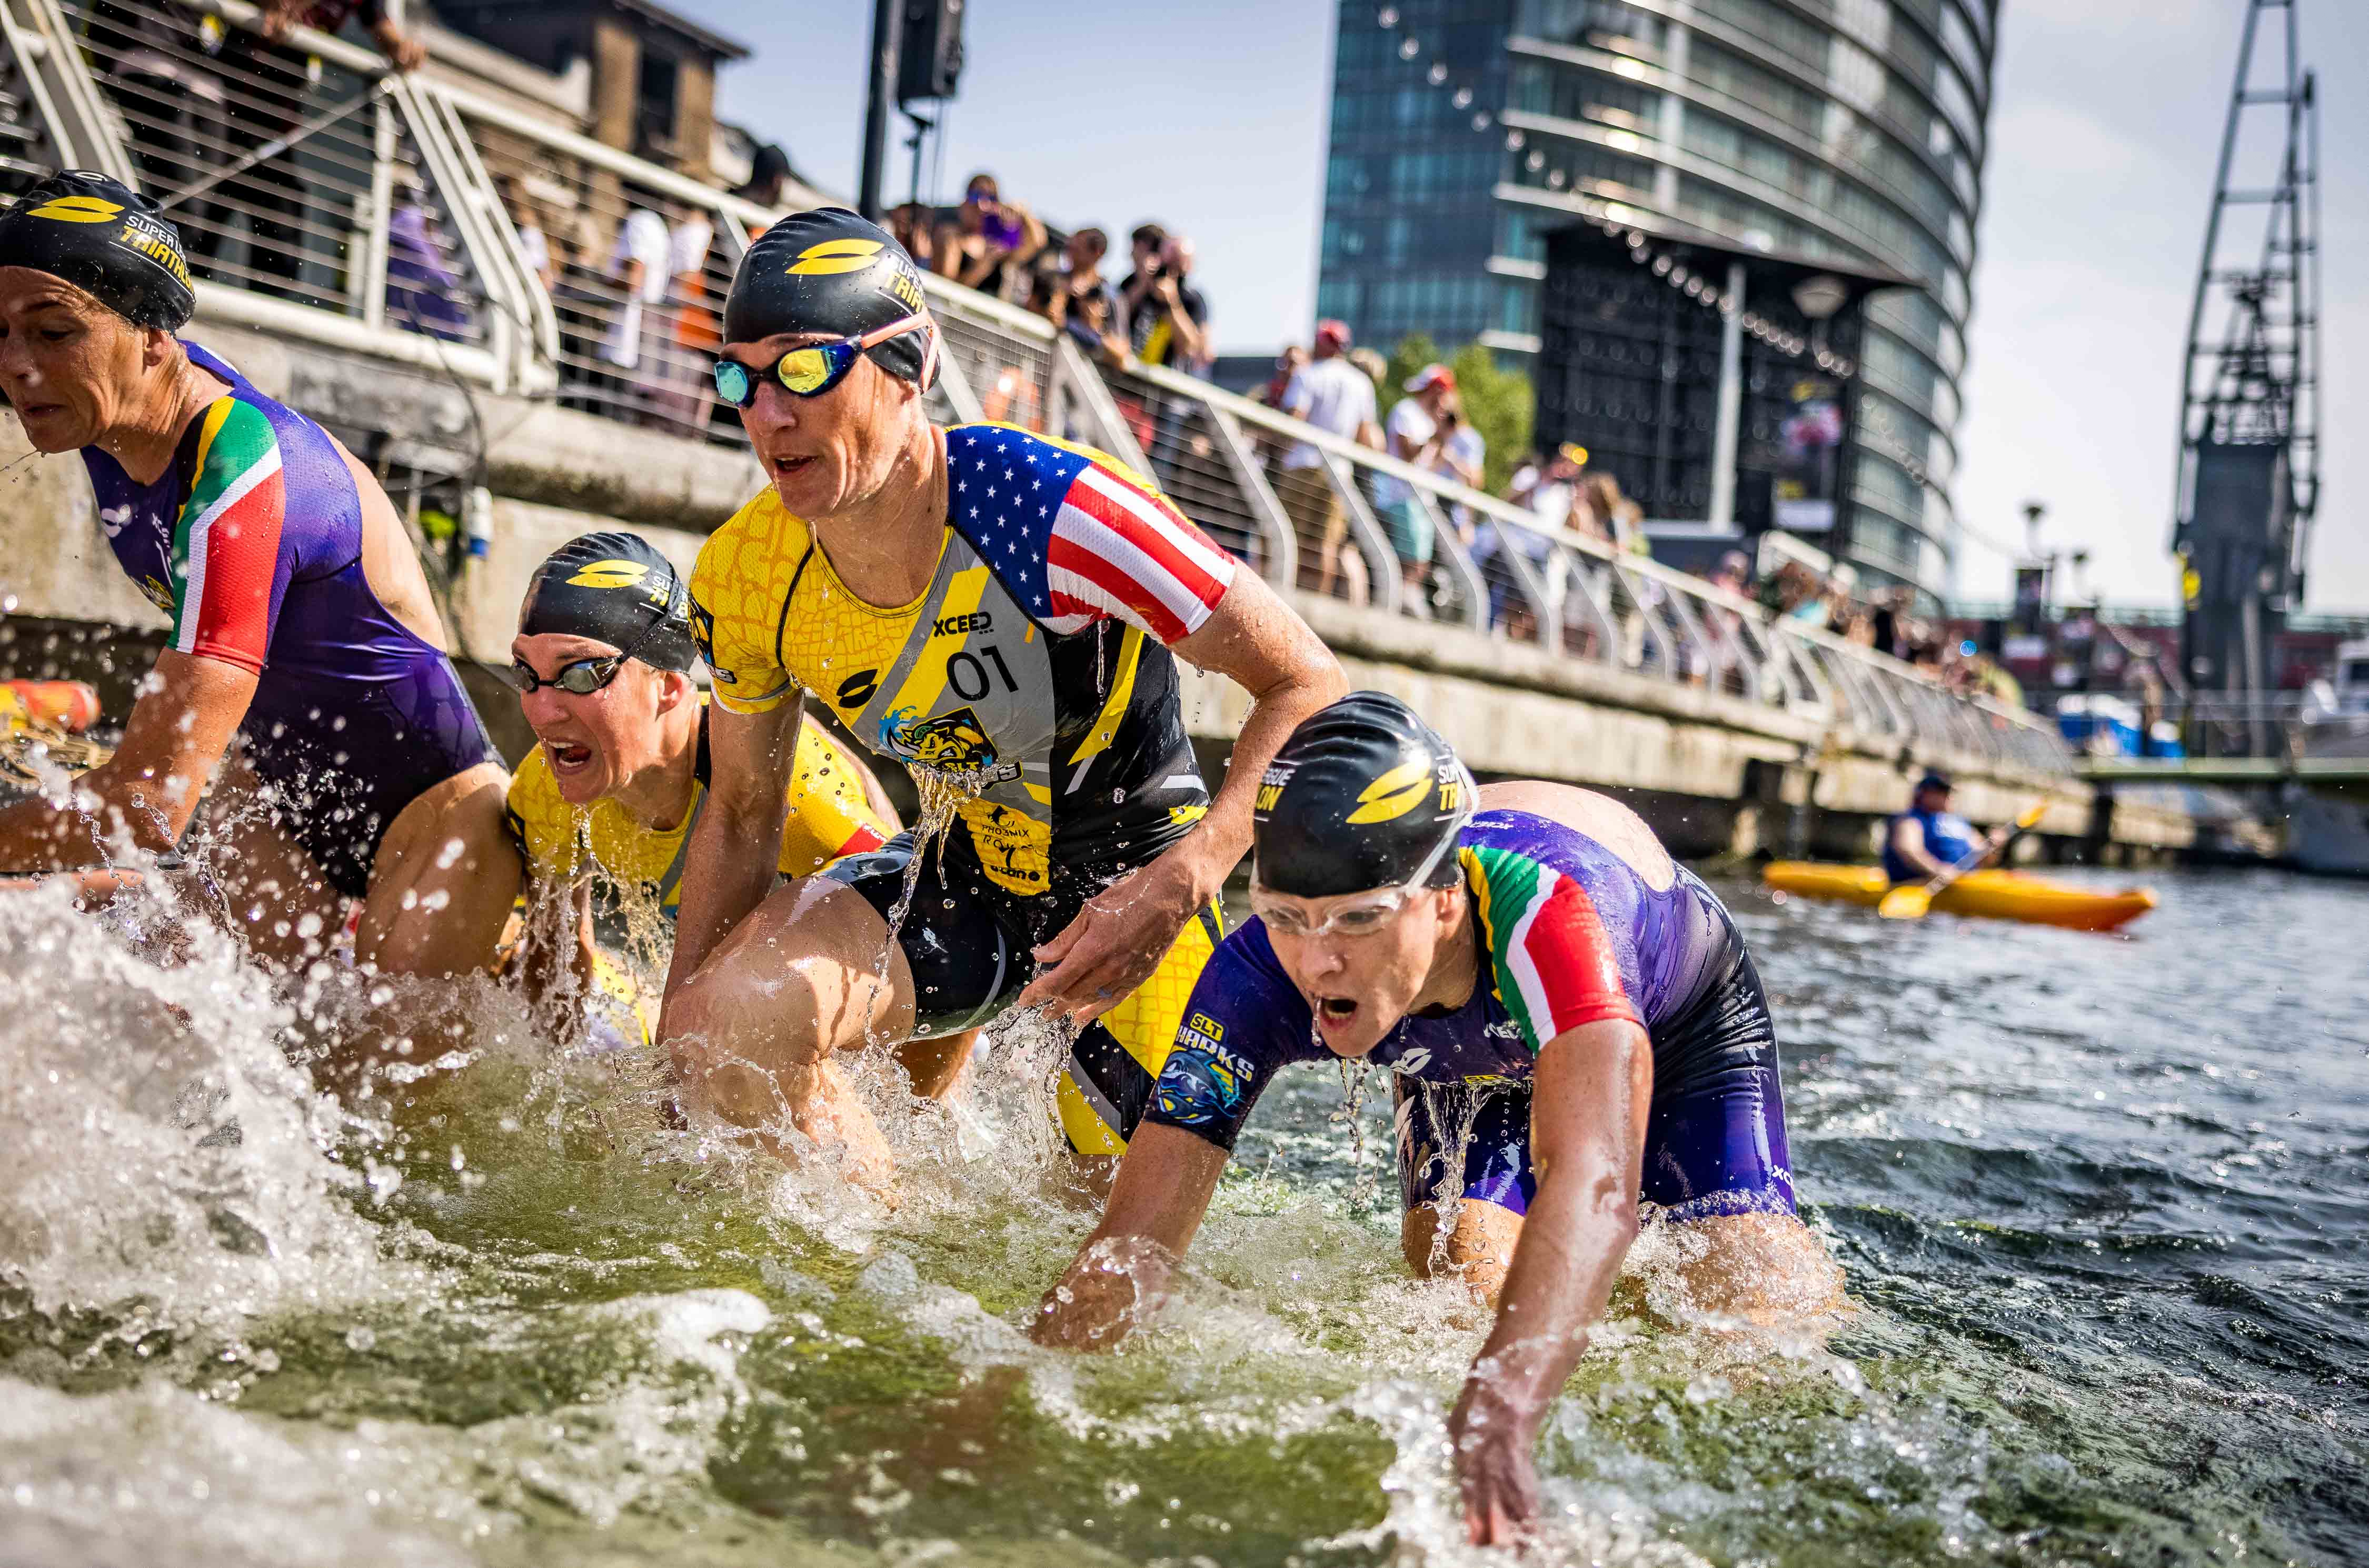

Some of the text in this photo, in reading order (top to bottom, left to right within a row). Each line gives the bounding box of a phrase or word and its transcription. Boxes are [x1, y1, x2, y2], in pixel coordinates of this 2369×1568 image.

[126, 215, 174, 247] SUPER
[933, 611, 992, 637] XCEED
[946, 645, 1019, 701] 01
[981, 824, 1030, 838] PHO3NIX
[1192, 1016, 1222, 1037] SLT
[1176, 1025, 1255, 1082] HARKS
